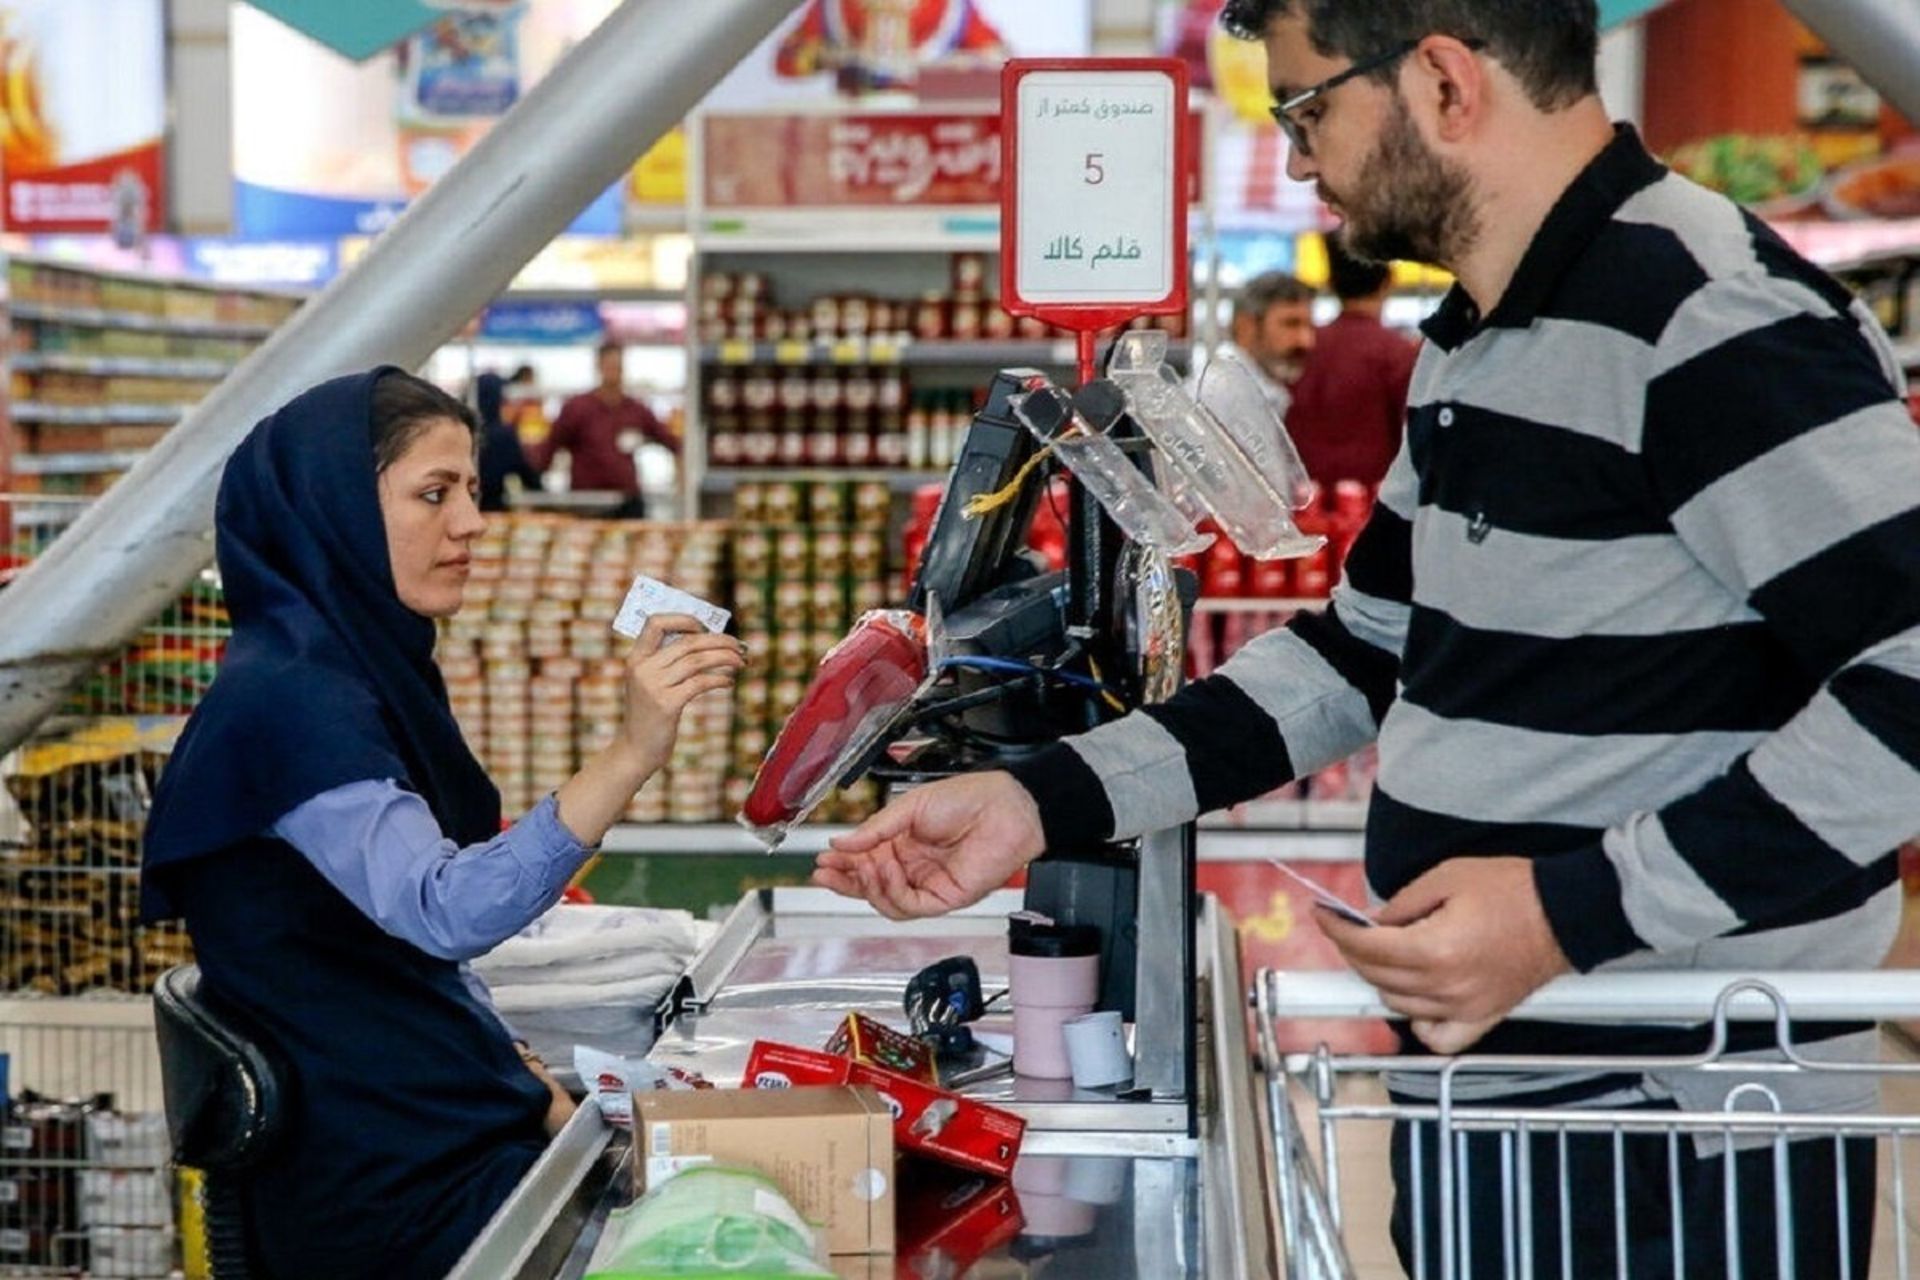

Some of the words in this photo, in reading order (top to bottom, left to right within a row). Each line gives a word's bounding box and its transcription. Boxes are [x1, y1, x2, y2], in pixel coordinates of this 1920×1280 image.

[1036, 98, 1049, 118] از
[1053, 96, 1091, 118] کمتر
[1093, 101, 1153, 119] صندوق
[1084, 153, 1104, 185] 5
[1043, 235, 1084, 260] کالا
[1090, 236, 1142, 269] قلم
